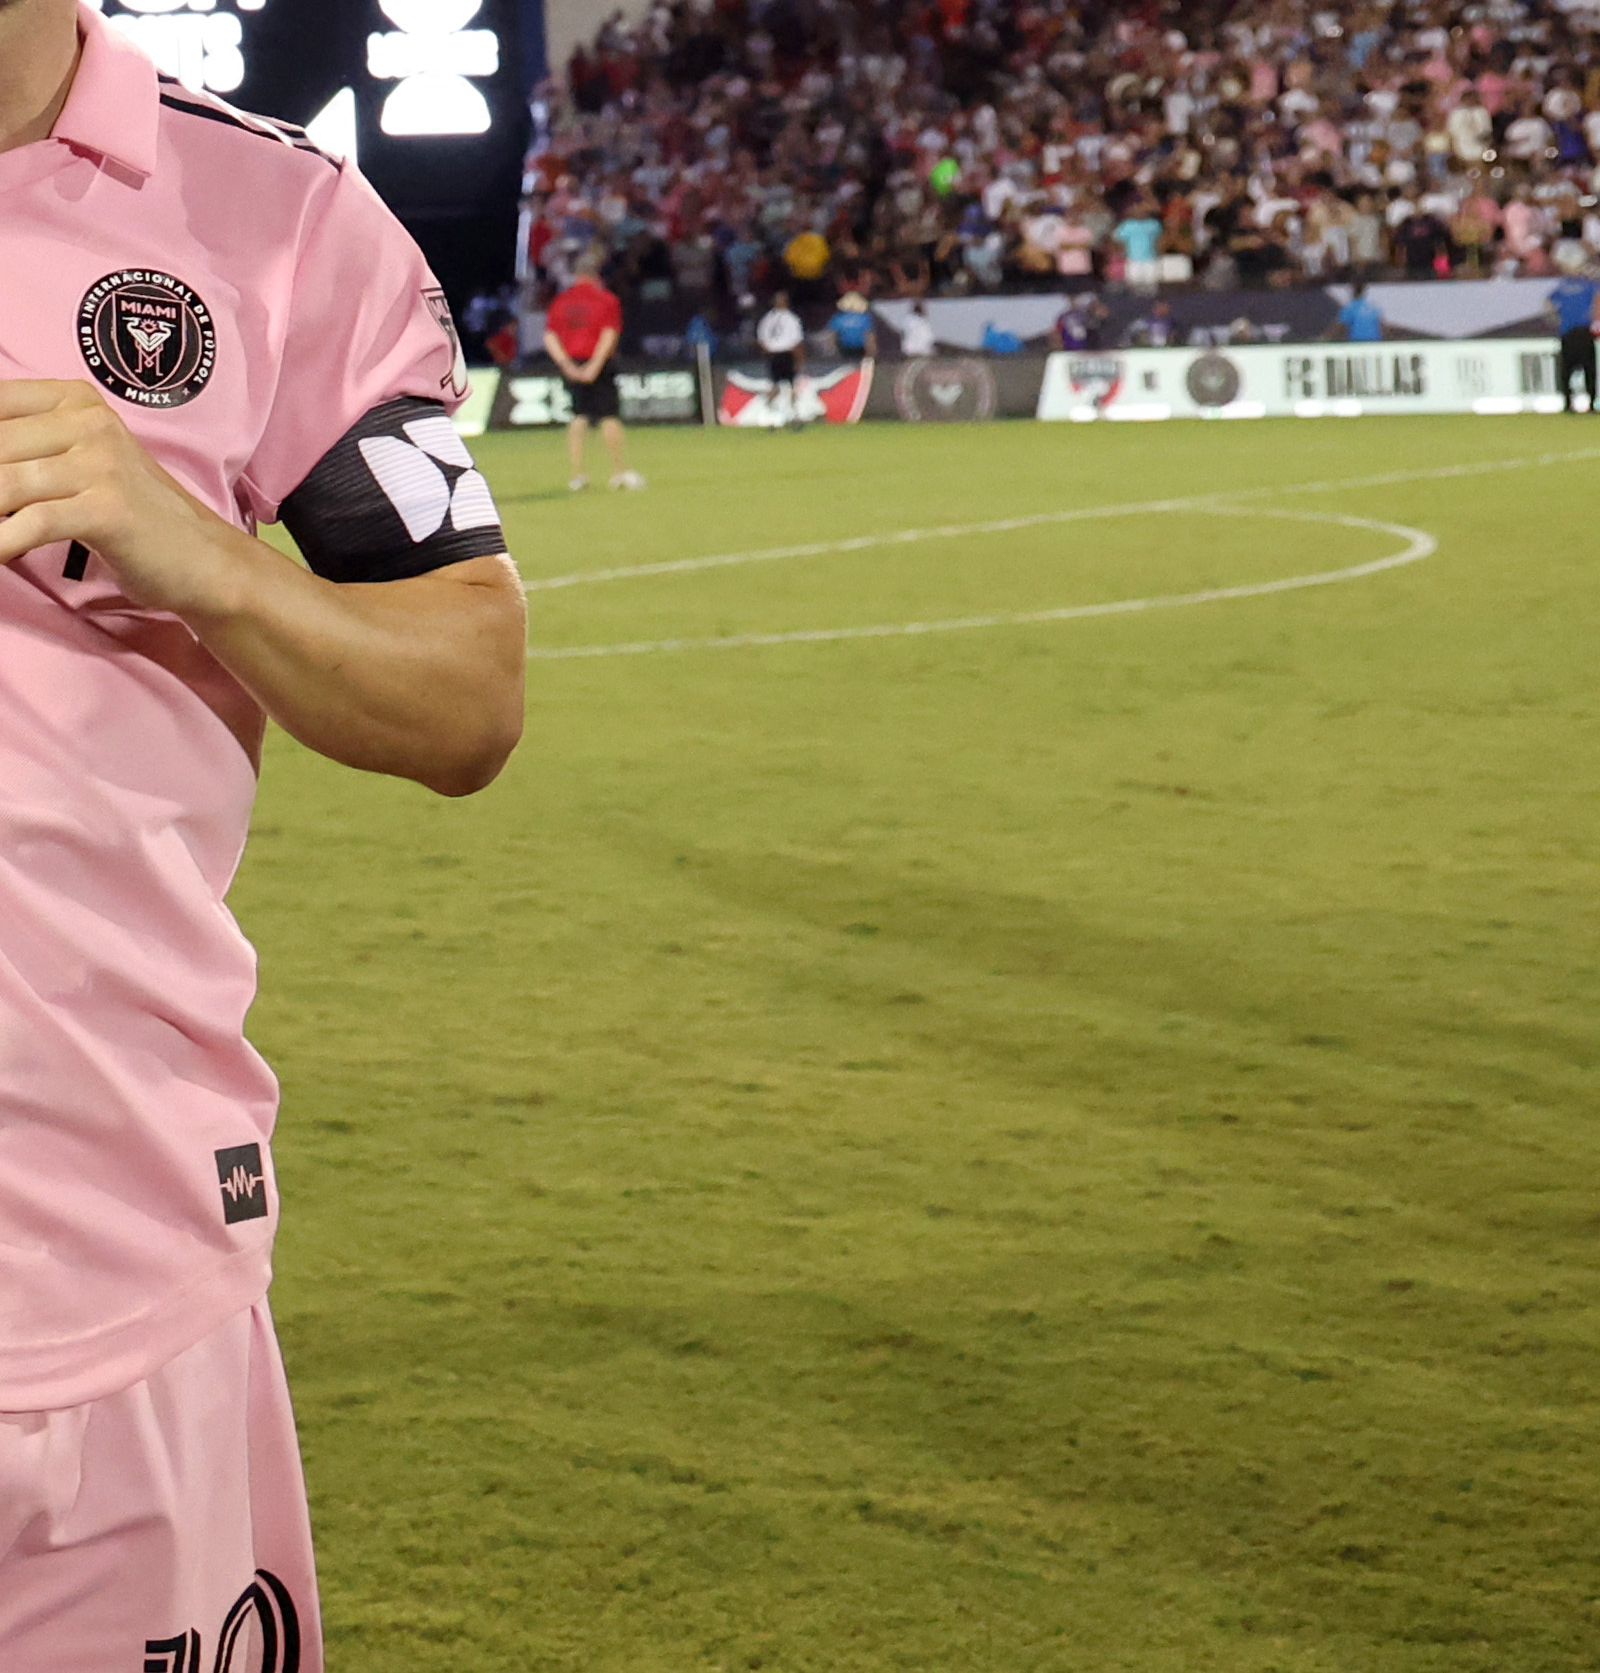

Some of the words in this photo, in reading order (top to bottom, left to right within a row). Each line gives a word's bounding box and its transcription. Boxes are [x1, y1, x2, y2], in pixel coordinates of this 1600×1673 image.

[81, 271, 193, 319] INTERNACIONAL
[120, 300, 177, 320] MIAMI
[193, 304, 210, 324] DE
[80, 325, 101, 367] CLUB
[193, 330, 215, 384] FUTBOL
[124, 387, 172, 405] MMXX
[1325, 355, 1423, 396] DALLAS
